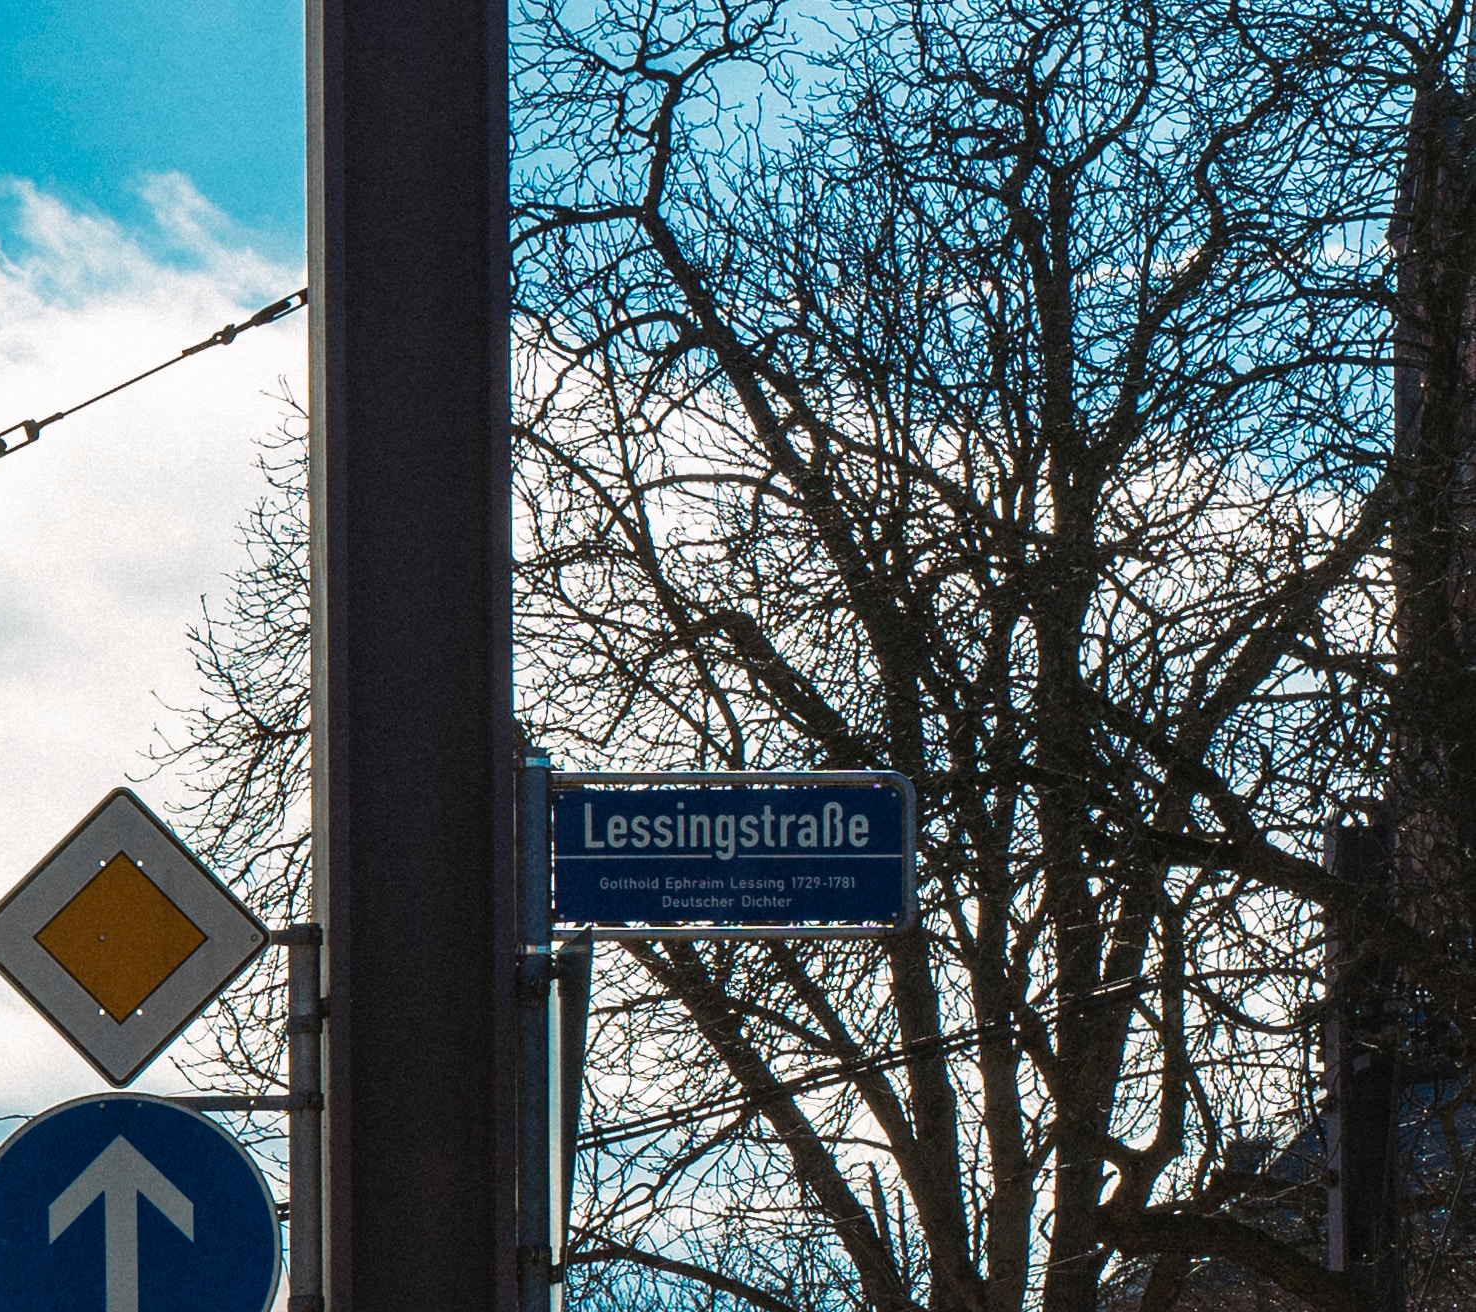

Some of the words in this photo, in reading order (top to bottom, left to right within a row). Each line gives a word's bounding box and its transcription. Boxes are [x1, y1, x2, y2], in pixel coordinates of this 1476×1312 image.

[584, 802, 869, 860] Lessingstraße
[599, 876, 659, 890] Gotthold
[665, 876, 724, 892] Ephraim
[730, 876, 785, 892] Lessing
[791, 876, 857, 890] 1729-1781
[662, 895, 735, 908] Deutscher
[741, 895, 793, 908] Dichter
